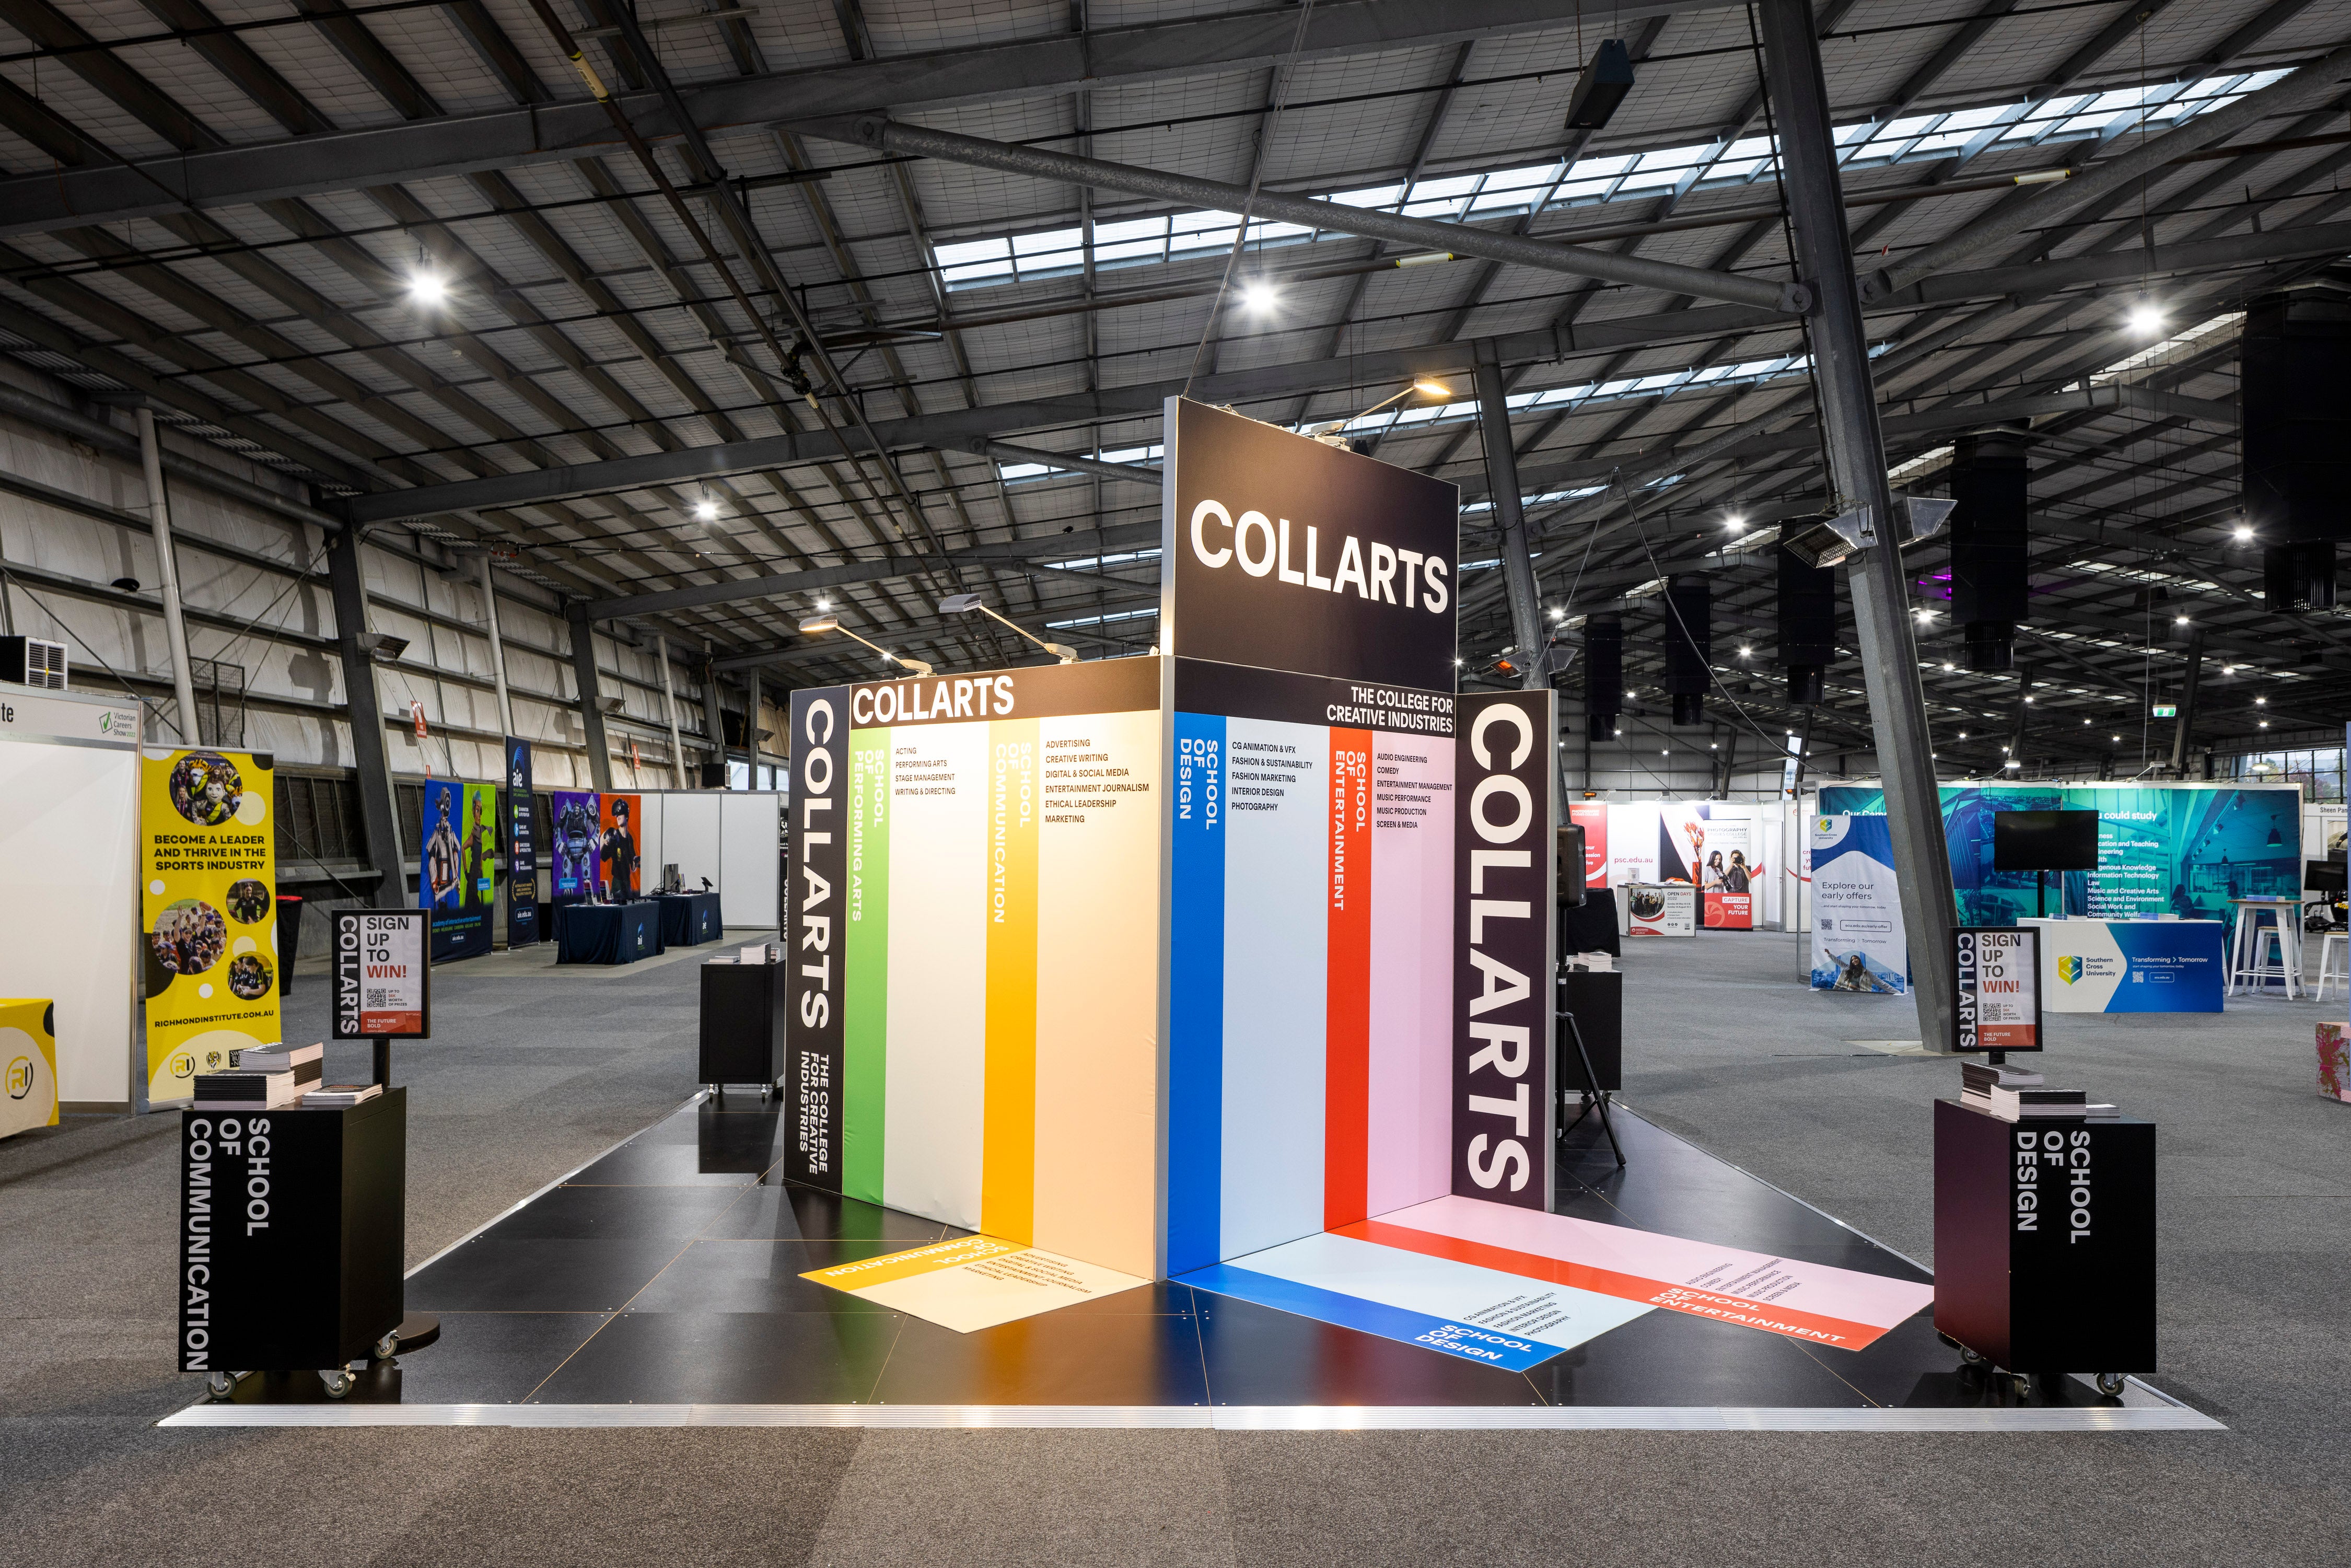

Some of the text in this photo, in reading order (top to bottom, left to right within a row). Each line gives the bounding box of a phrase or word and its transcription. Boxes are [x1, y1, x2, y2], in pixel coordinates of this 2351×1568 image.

[1191, 500, 1448, 613] COLLARTS
[853, 675, 1014, 724] COLLARTS
[1351, 686, 1452, 713] THE COLLEGE FOR
[114, 712, 136, 721] Victorian
[114, 721, 132, 729] Careers
[1327, 704, 1452, 733] CREATIVE INDUSTRIES
[1046, 739, 1090, 748] ADVERTISING
[1194, 739, 1205, 767] OF
[1243, 743, 1278, 752] ANIMATION
[865, 750, 874, 774] OF
[1008, 743, 1018, 769] OF
[1046, 753, 1108, 763] CREATIVE WRITING
[1232, 757, 1260, 765] FASHION
[1266, 759, 1312, 769] SUSTAINABILITY
[1346, 751, 1355, 776] OF
[1377, 753, 1427, 763] AUDIO ENGINEERING
[513, 769, 522, 787] aie
[874, 749, 884, 827] SCHOOL
[914, 773, 955, 782] MANAGEMENT
[1020, 742, 1031, 828] SCHOOL
[1046, 784, 1149, 793] ENTERTAINMENT JOURNALISM
[1180, 738, 1191, 819] DESIGN
[1206, 739, 1218, 829] SCHOOL
[1232, 772, 1296, 783] FASHION MARKETING
[1377, 780, 1452, 792] ENTERTAINMENT MANAGEMENT
[1232, 787, 1284, 797] INTERIOR DESIGN
[1356, 751, 1366, 832] SCHOOL
[1394, 794, 1431, 803] PERFORMANCE
[1075, 799, 1116, 808] LEADERSHIP
[1231, 802, 1278, 811] PHOTOGRAPHY
[2104, 811, 2157, 821] could study
[155, 835, 205, 844] BECOME
[209, 835, 217, 844] A
[853, 751, 864, 921] PERFORMING ARTS
[994, 744, 1006, 923] COMMUNICATION
[1334, 750, 1345, 910] ENTERTAINMENT
[154, 849, 180, 857] AND
[184, 849, 227, 857] THRIVE
[801, 699, 834, 1028] COLLARTS
[156, 861, 265, 870] SPORTS INDUSTRY
[1822, 892, 1844, 900] early
[367, 917, 409, 930] SIGN
[367, 933, 389, 946] UP
[1468, 703, 1532, 1193] COLLARTS
[1982, 934, 2021, 947] SIGN
[367, 949, 390, 962] TO
[1983, 950, 2003, 962] UP
[340, 916, 358, 1033] COLLARTS
[367, 965, 406, 978] WIN!
[1983, 966, 2004, 978] TO
[1958, 933, 1976, 1046] COLLARTS
[1983, 981, 2019, 993] WIN!
[155, 1010, 274, 1028] RICHMONDINSTITUTE.COM.AU
[800, 1051, 809, 1152] INDUSTRIES
[819, 1054, 829, 1172] THE COLLEGE
[219, 1119, 241, 1156] OF
[809, 1091, 819, 1175] CREATIVE
[2044, 1131, 2064, 1166] OF
[247, 1118, 270, 1236] SCHOOL
[2017, 1132, 2037, 1230] DESIGN
[2070, 1131, 2090, 1244] SCHOOL
[187, 1119, 212, 1370] COMMUNICATION
[1660, 1293, 1692, 1301] OF
[1668, 1288, 1760, 1311] SCHOOL
[1649, 1296, 1845, 1341] ENTERTAINMENT
[1429, 1330, 1463, 1340] OF
[1440, 1325, 1533, 1352] SCHOOL
[1414, 1334, 1503, 1360] DESIGN
